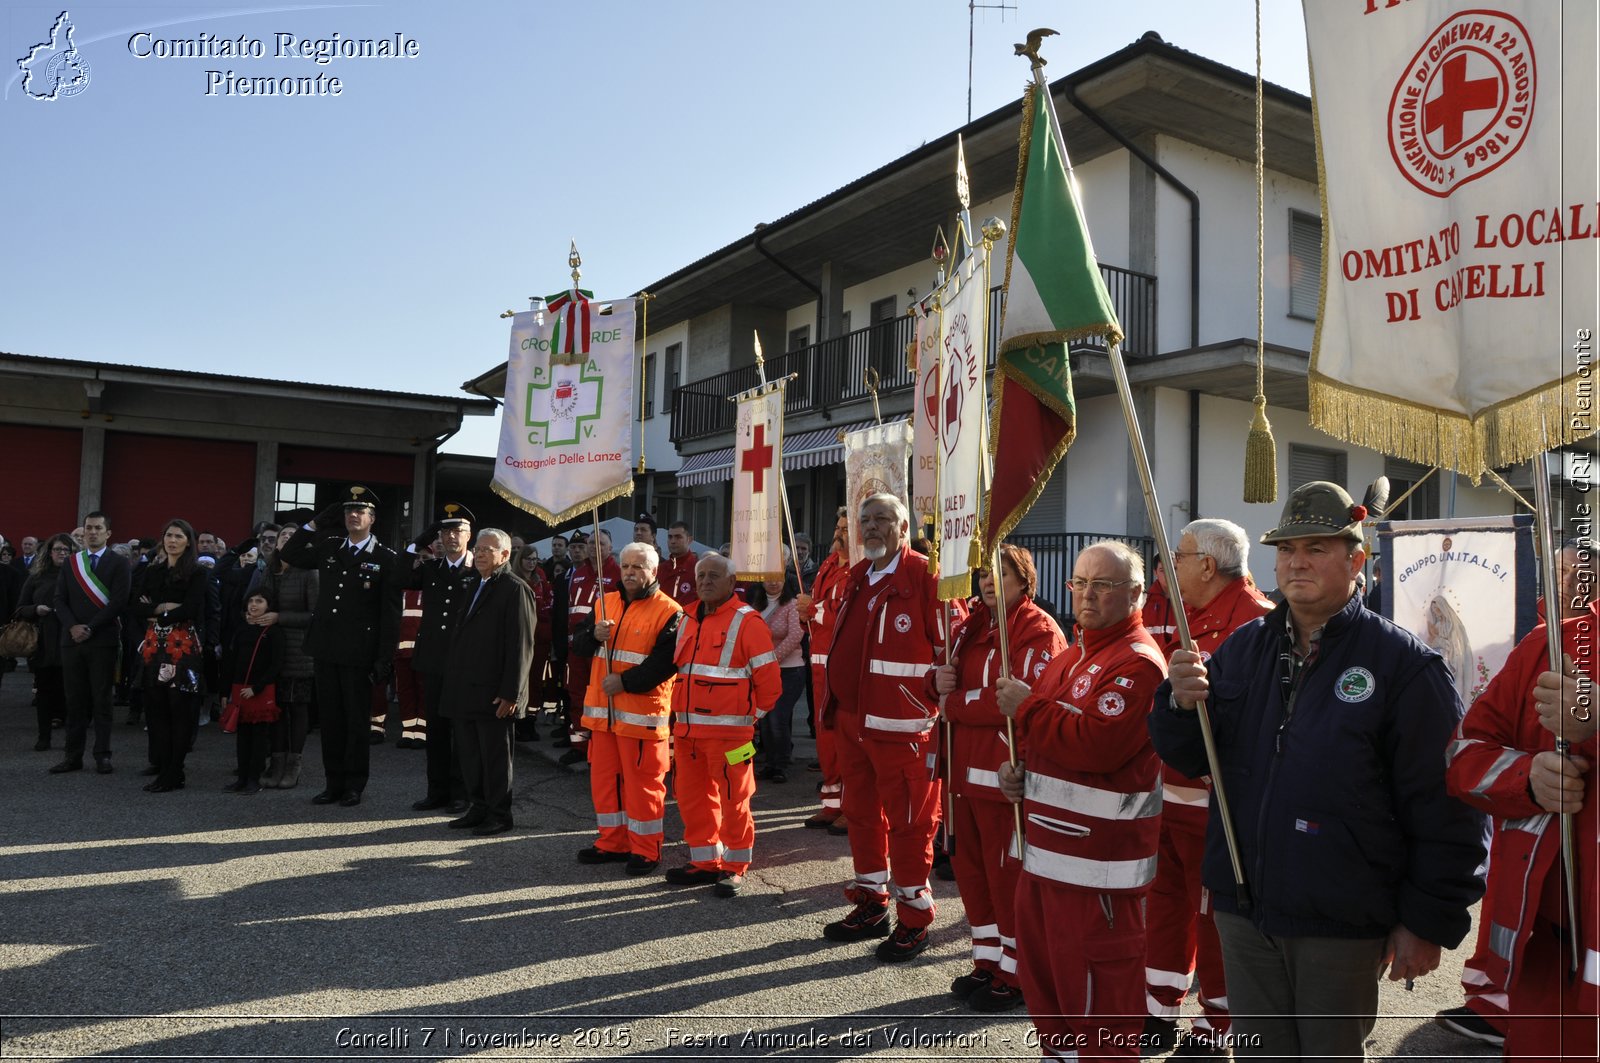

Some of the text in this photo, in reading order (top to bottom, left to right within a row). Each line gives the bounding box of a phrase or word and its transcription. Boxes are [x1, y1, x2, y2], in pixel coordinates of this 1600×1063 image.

[1399, 21, 1530, 185] CONVENZIONE DI GINEVRA 22 AGOSTO 1864
[1341, 202, 1600, 282] OMITATO LOCAL
[1385, 261, 1545, 323] DI CANELLI
[591, 328, 622, 344] RDE
[533, 359, 602, 380] P. A.
[527, 425, 597, 445] C. V.
[504, 451, 622, 470] Castagnole Delle Lanze
[1399, 553, 1437, 583] GRUPPO
